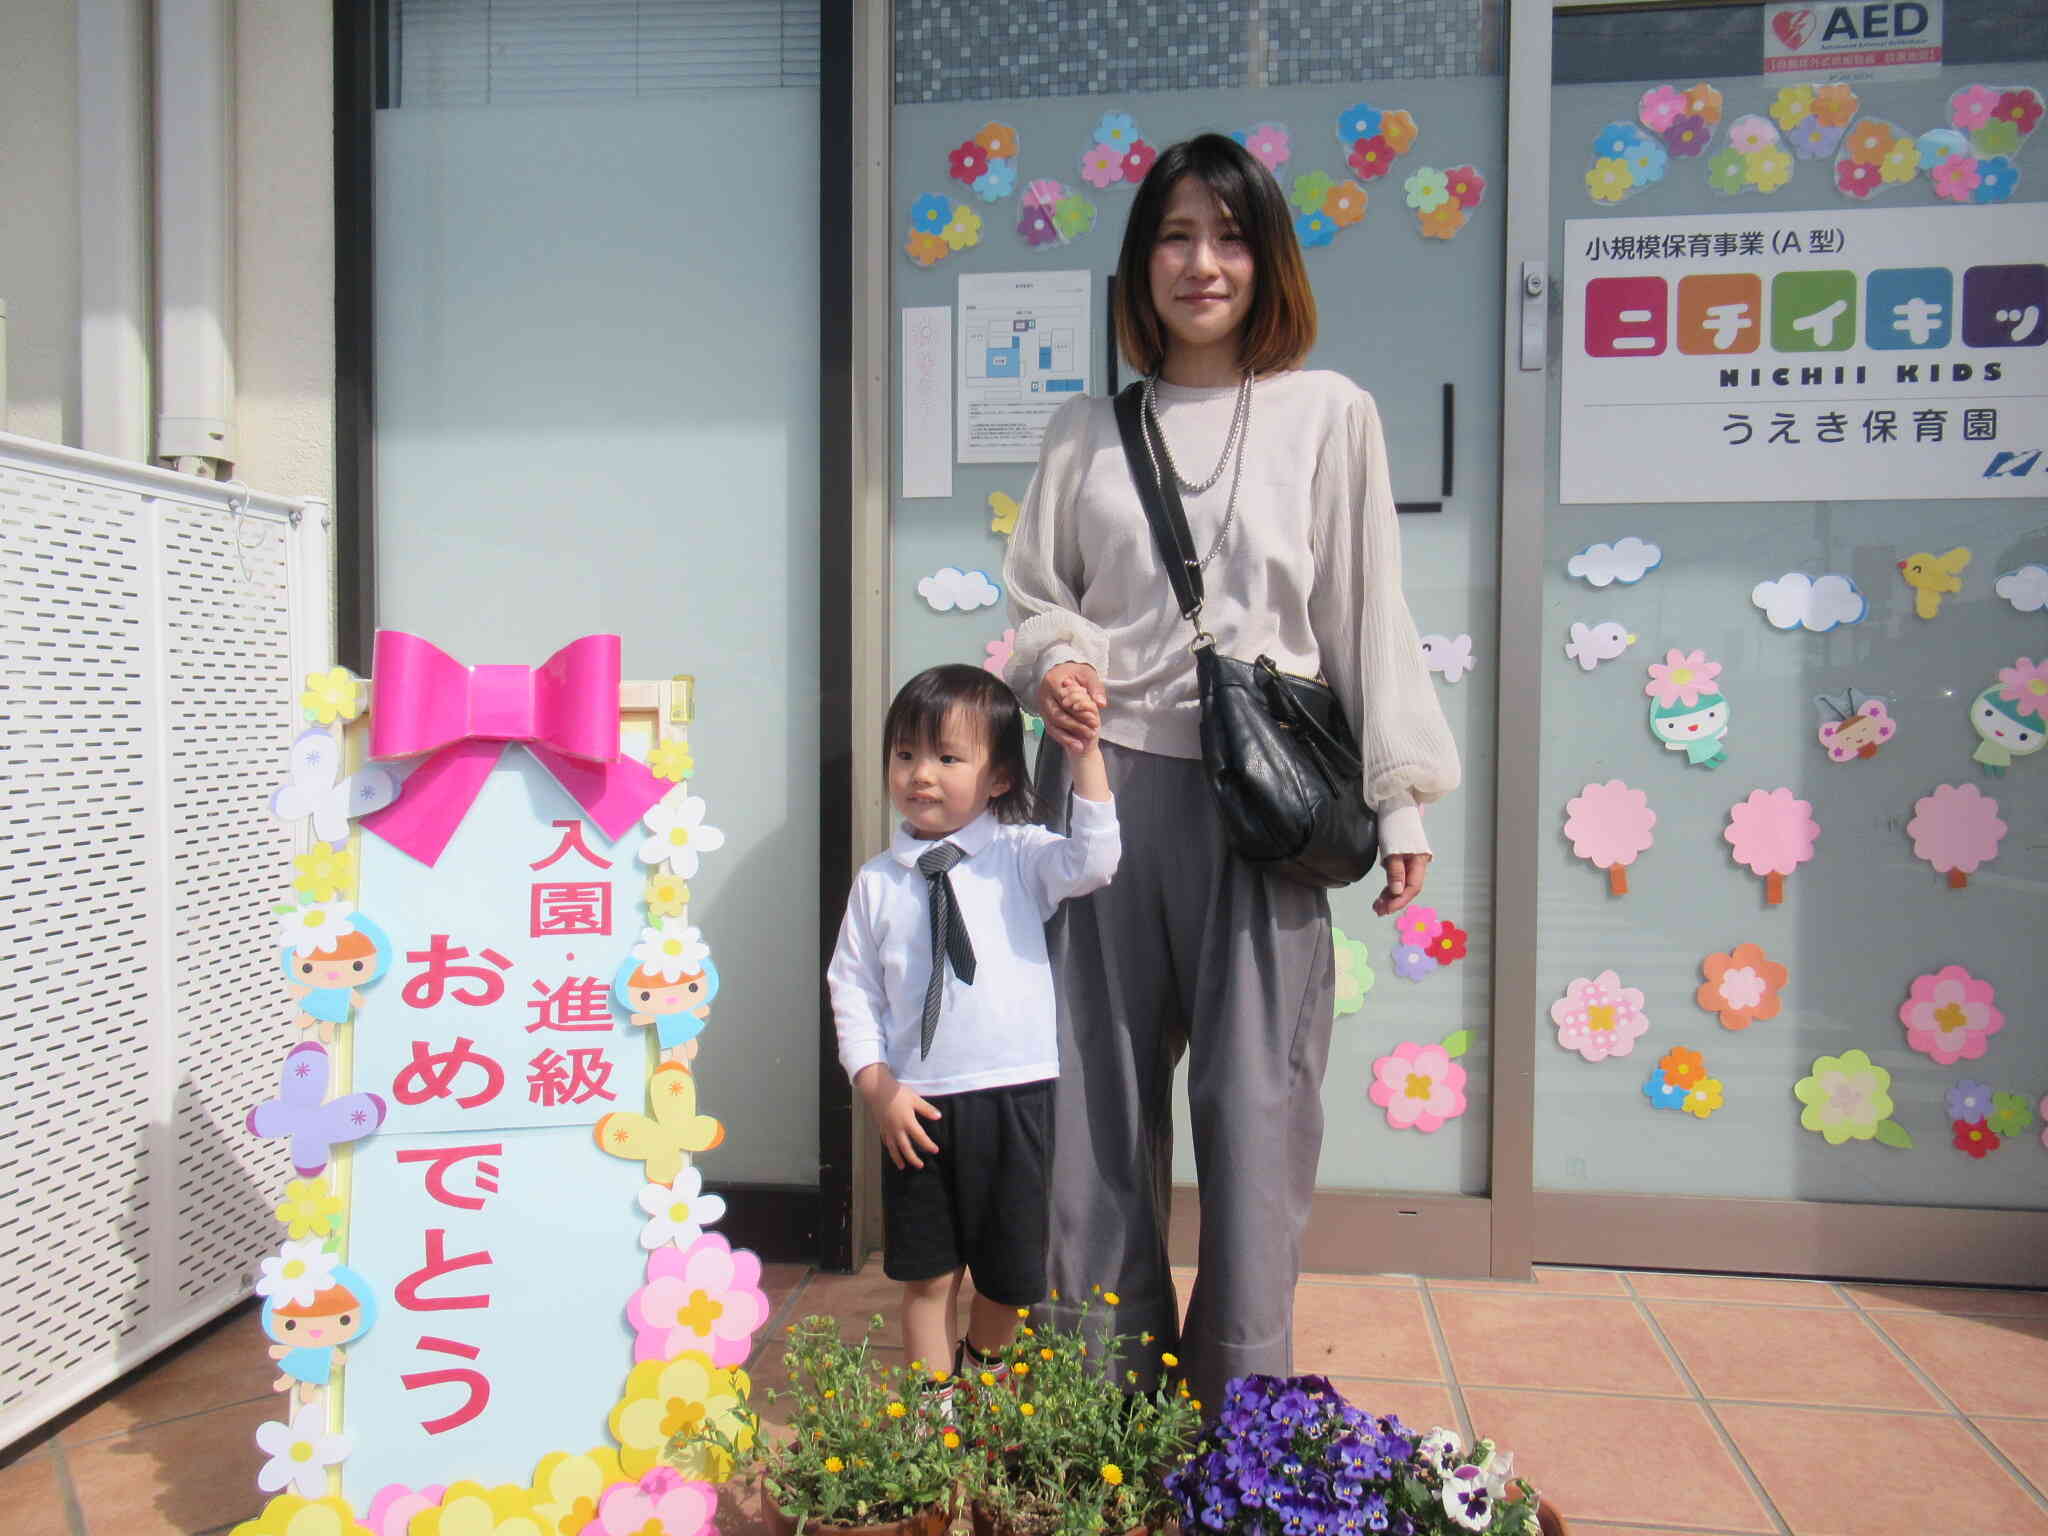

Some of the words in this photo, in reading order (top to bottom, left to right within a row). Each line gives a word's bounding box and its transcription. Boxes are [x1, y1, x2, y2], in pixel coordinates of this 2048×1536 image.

[1822, 3, 1929, 41] AED
[1719, 366, 1866, 388] NICHII
[1896, 362, 2002, 383] KIDS
[1722, 407, 1998, 445] うえき保育園
[526, 819, 618, 1107] 入園・進級
[392, 933, 513, 1435] おめでとう
